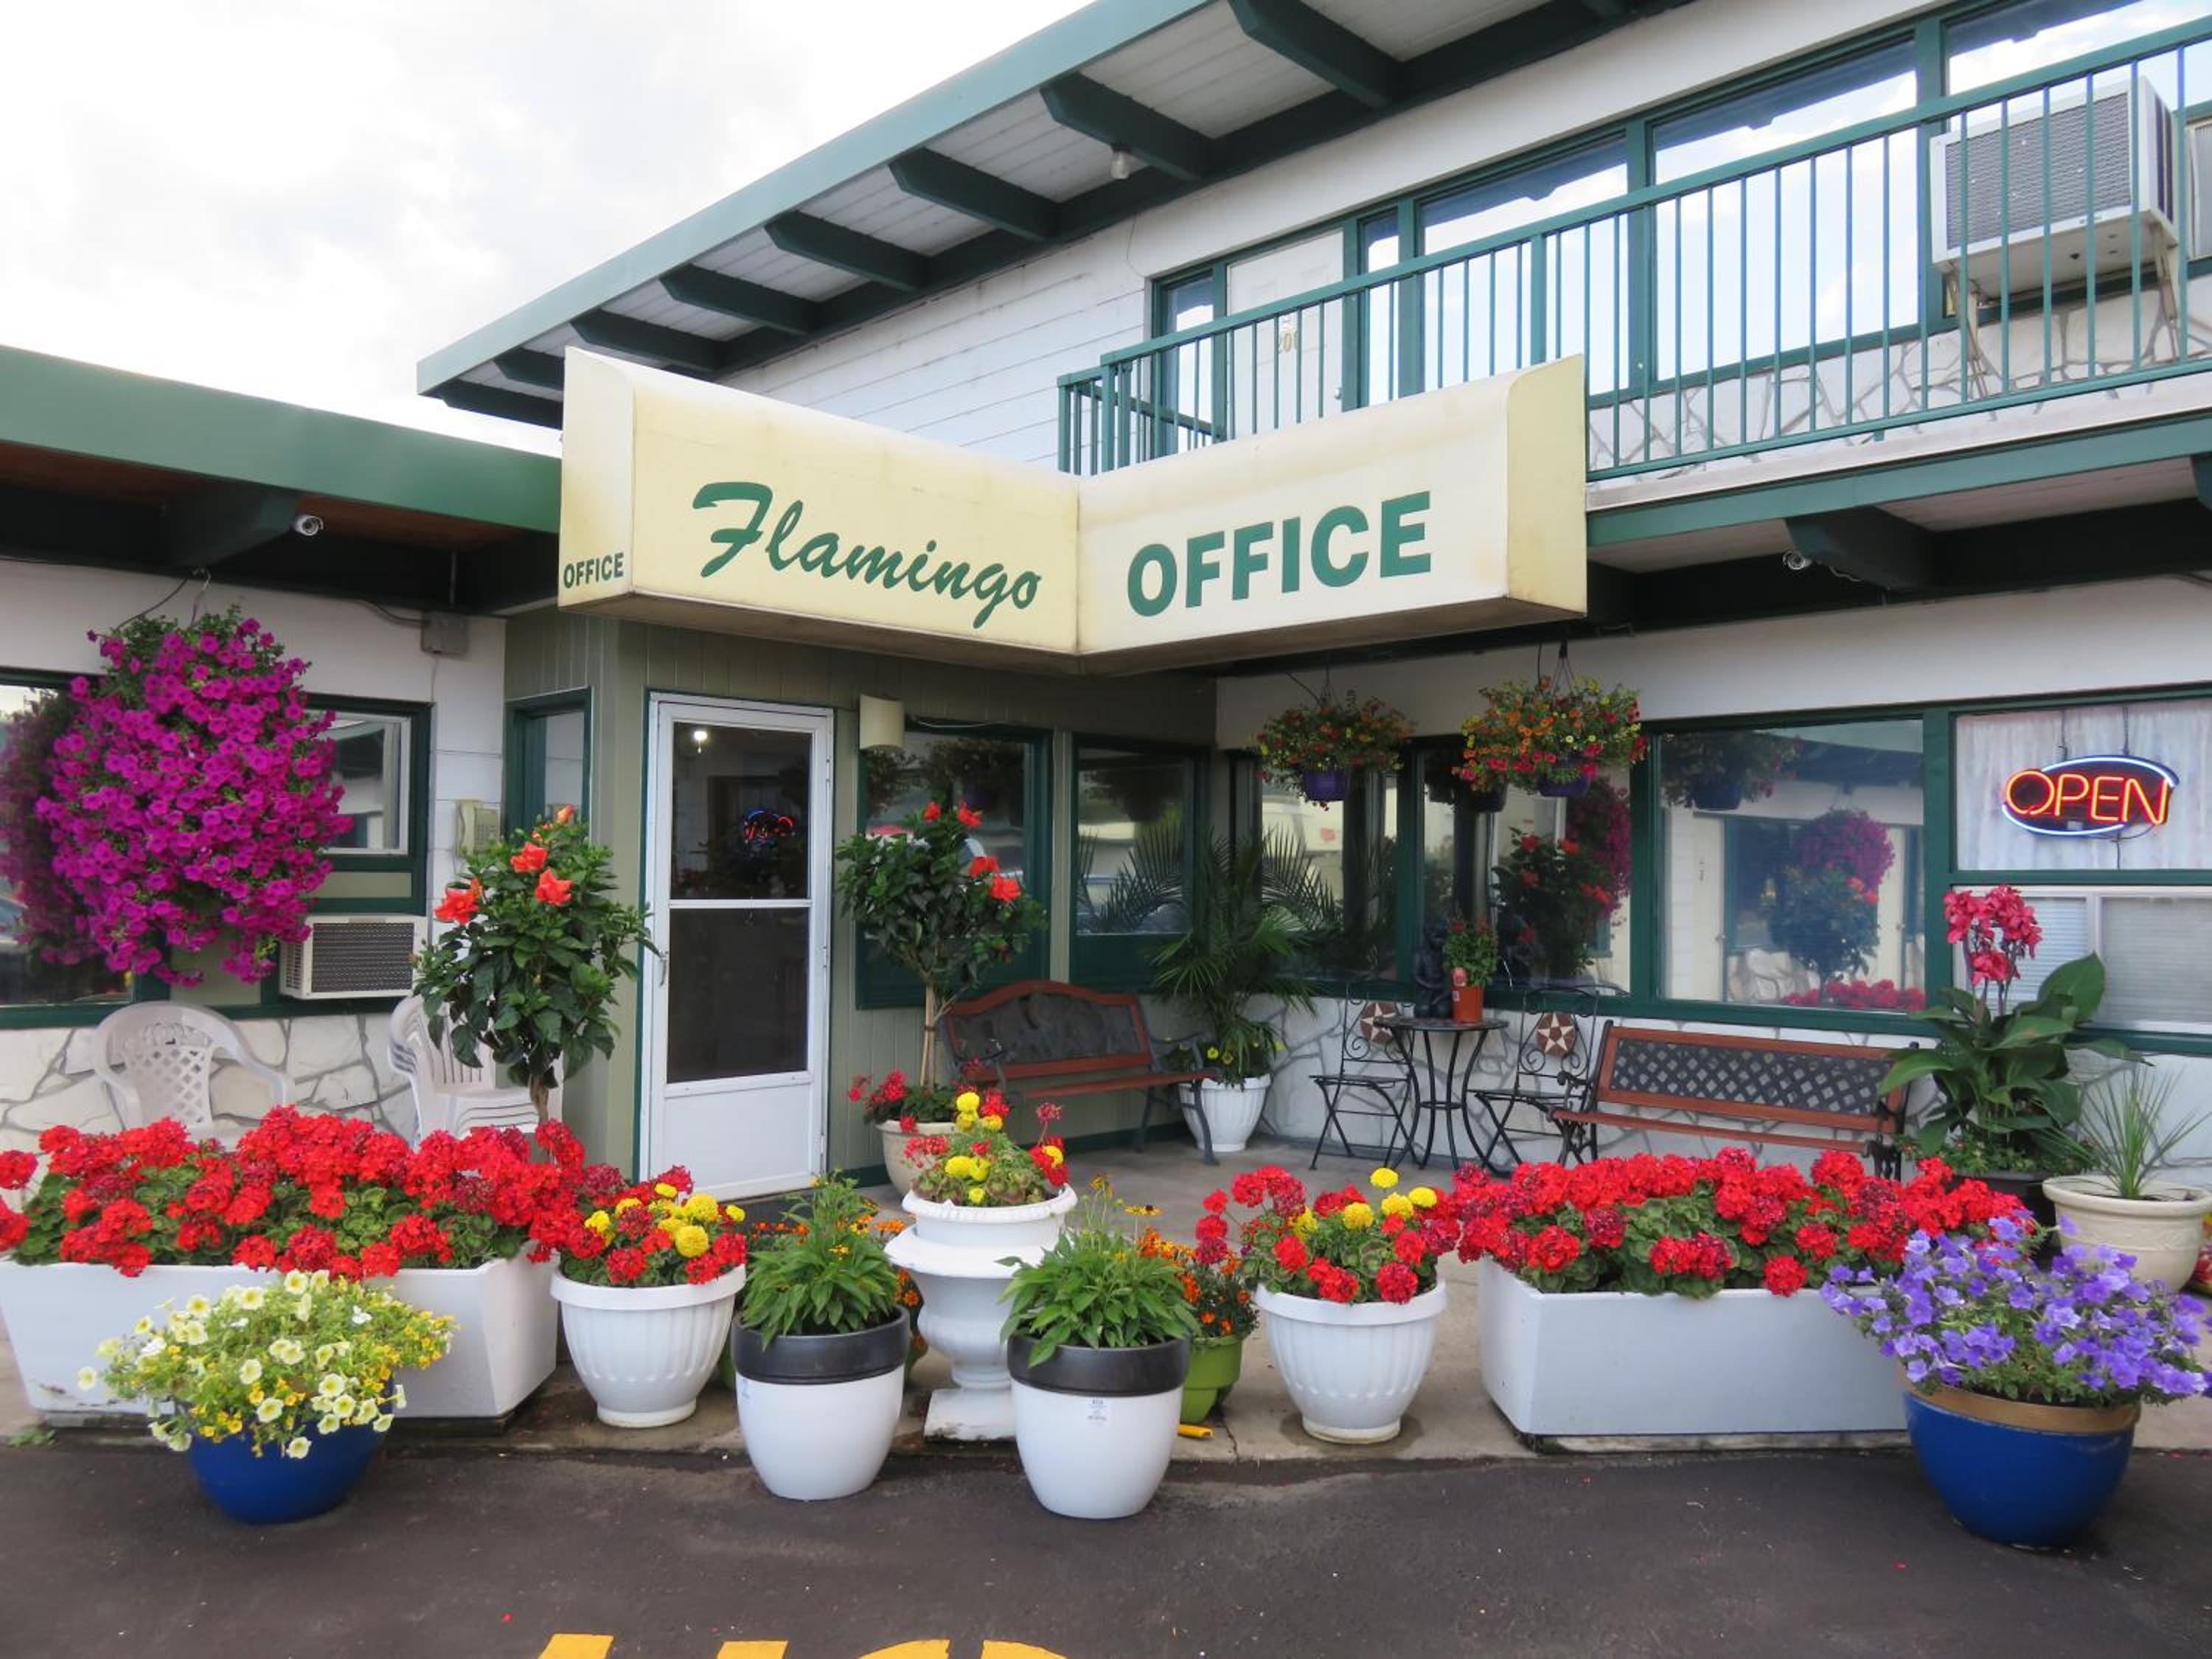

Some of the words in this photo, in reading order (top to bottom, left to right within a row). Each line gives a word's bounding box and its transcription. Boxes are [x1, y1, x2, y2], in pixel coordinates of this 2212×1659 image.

[563, 552, 624, 589] OFFICE
[693, 481, 1041, 628] Flamingo
[1127, 492, 1431, 616] OFFICE
[2005, 769, 2171, 825] OPEN
